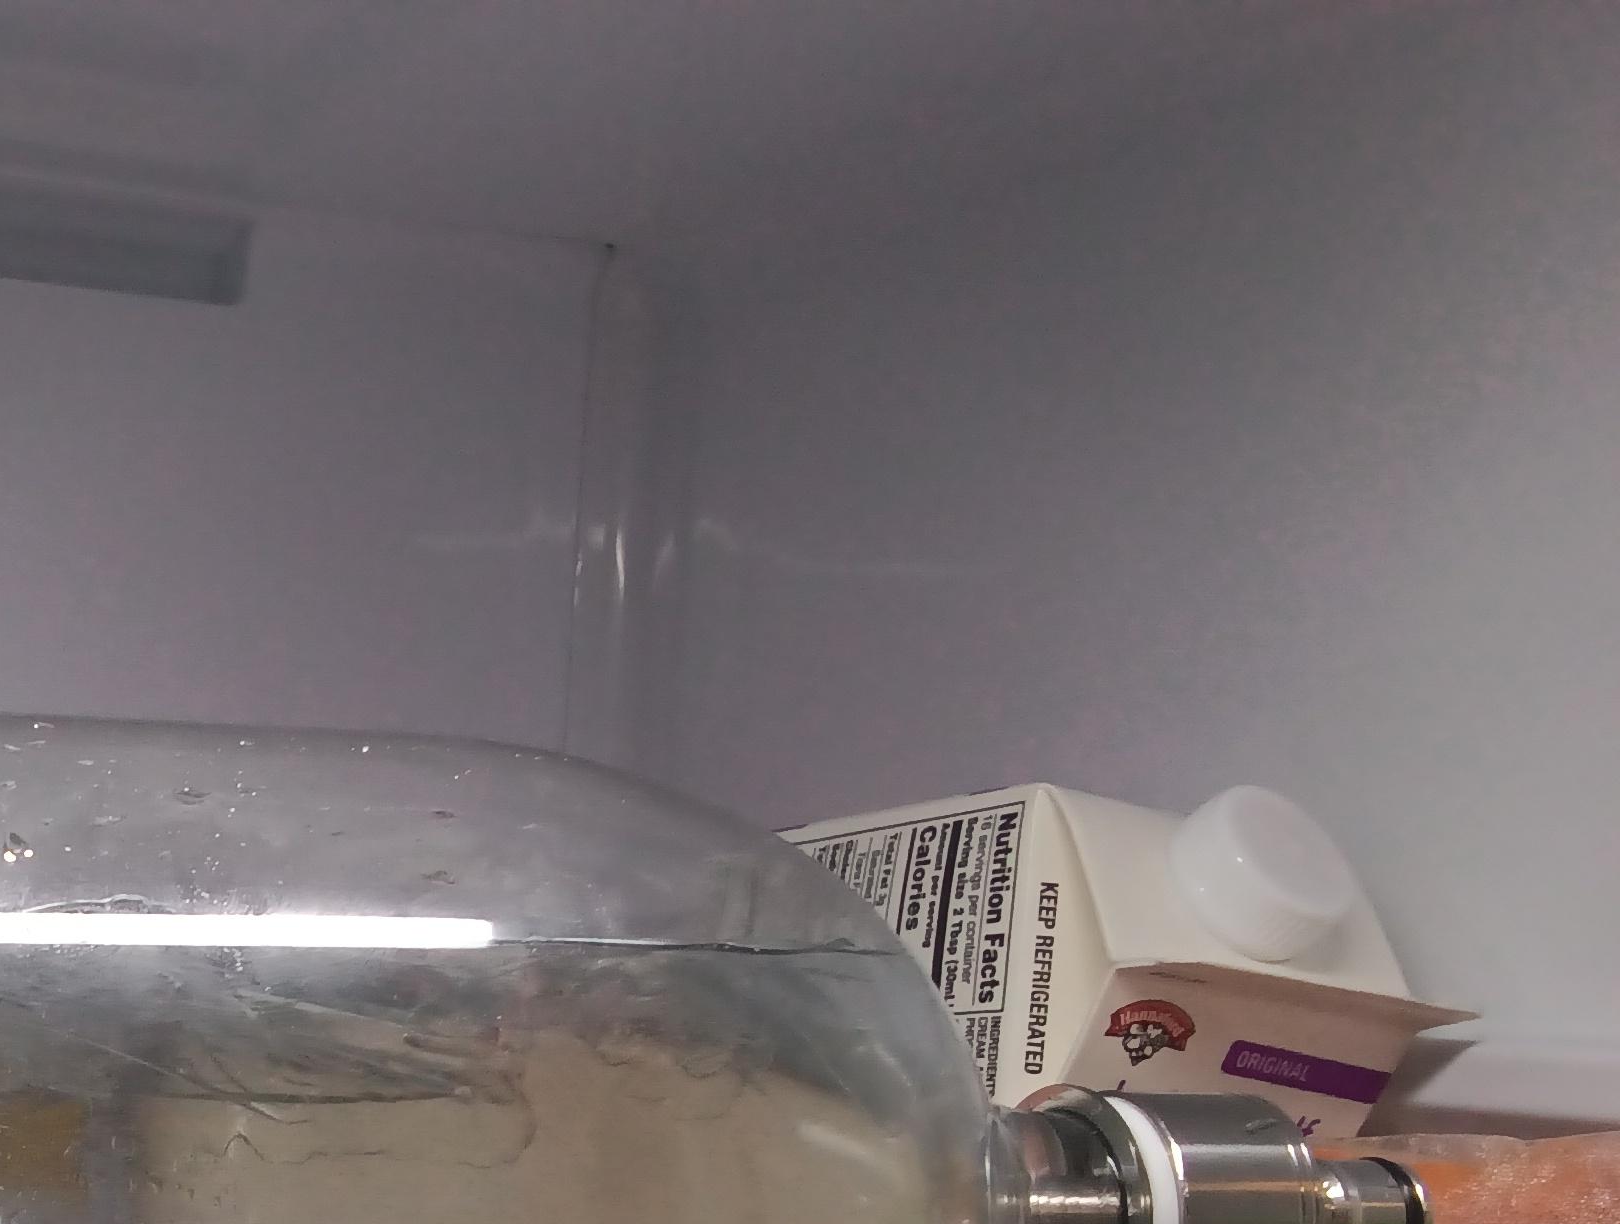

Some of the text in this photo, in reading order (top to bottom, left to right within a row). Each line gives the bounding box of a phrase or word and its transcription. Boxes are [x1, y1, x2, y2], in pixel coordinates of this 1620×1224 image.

[905, 825, 938, 931] Calories
[969, 834, 988, 891] servings
[967, 894, 980, 917] per
[978, 811, 1019, 1005] Nutrition Facts
[961, 920, 979, 985] container
[1024, 882, 1060, 1075] KEEP REFRIGERATED
[1235, 1050, 1312, 1083] ORIGINAL
